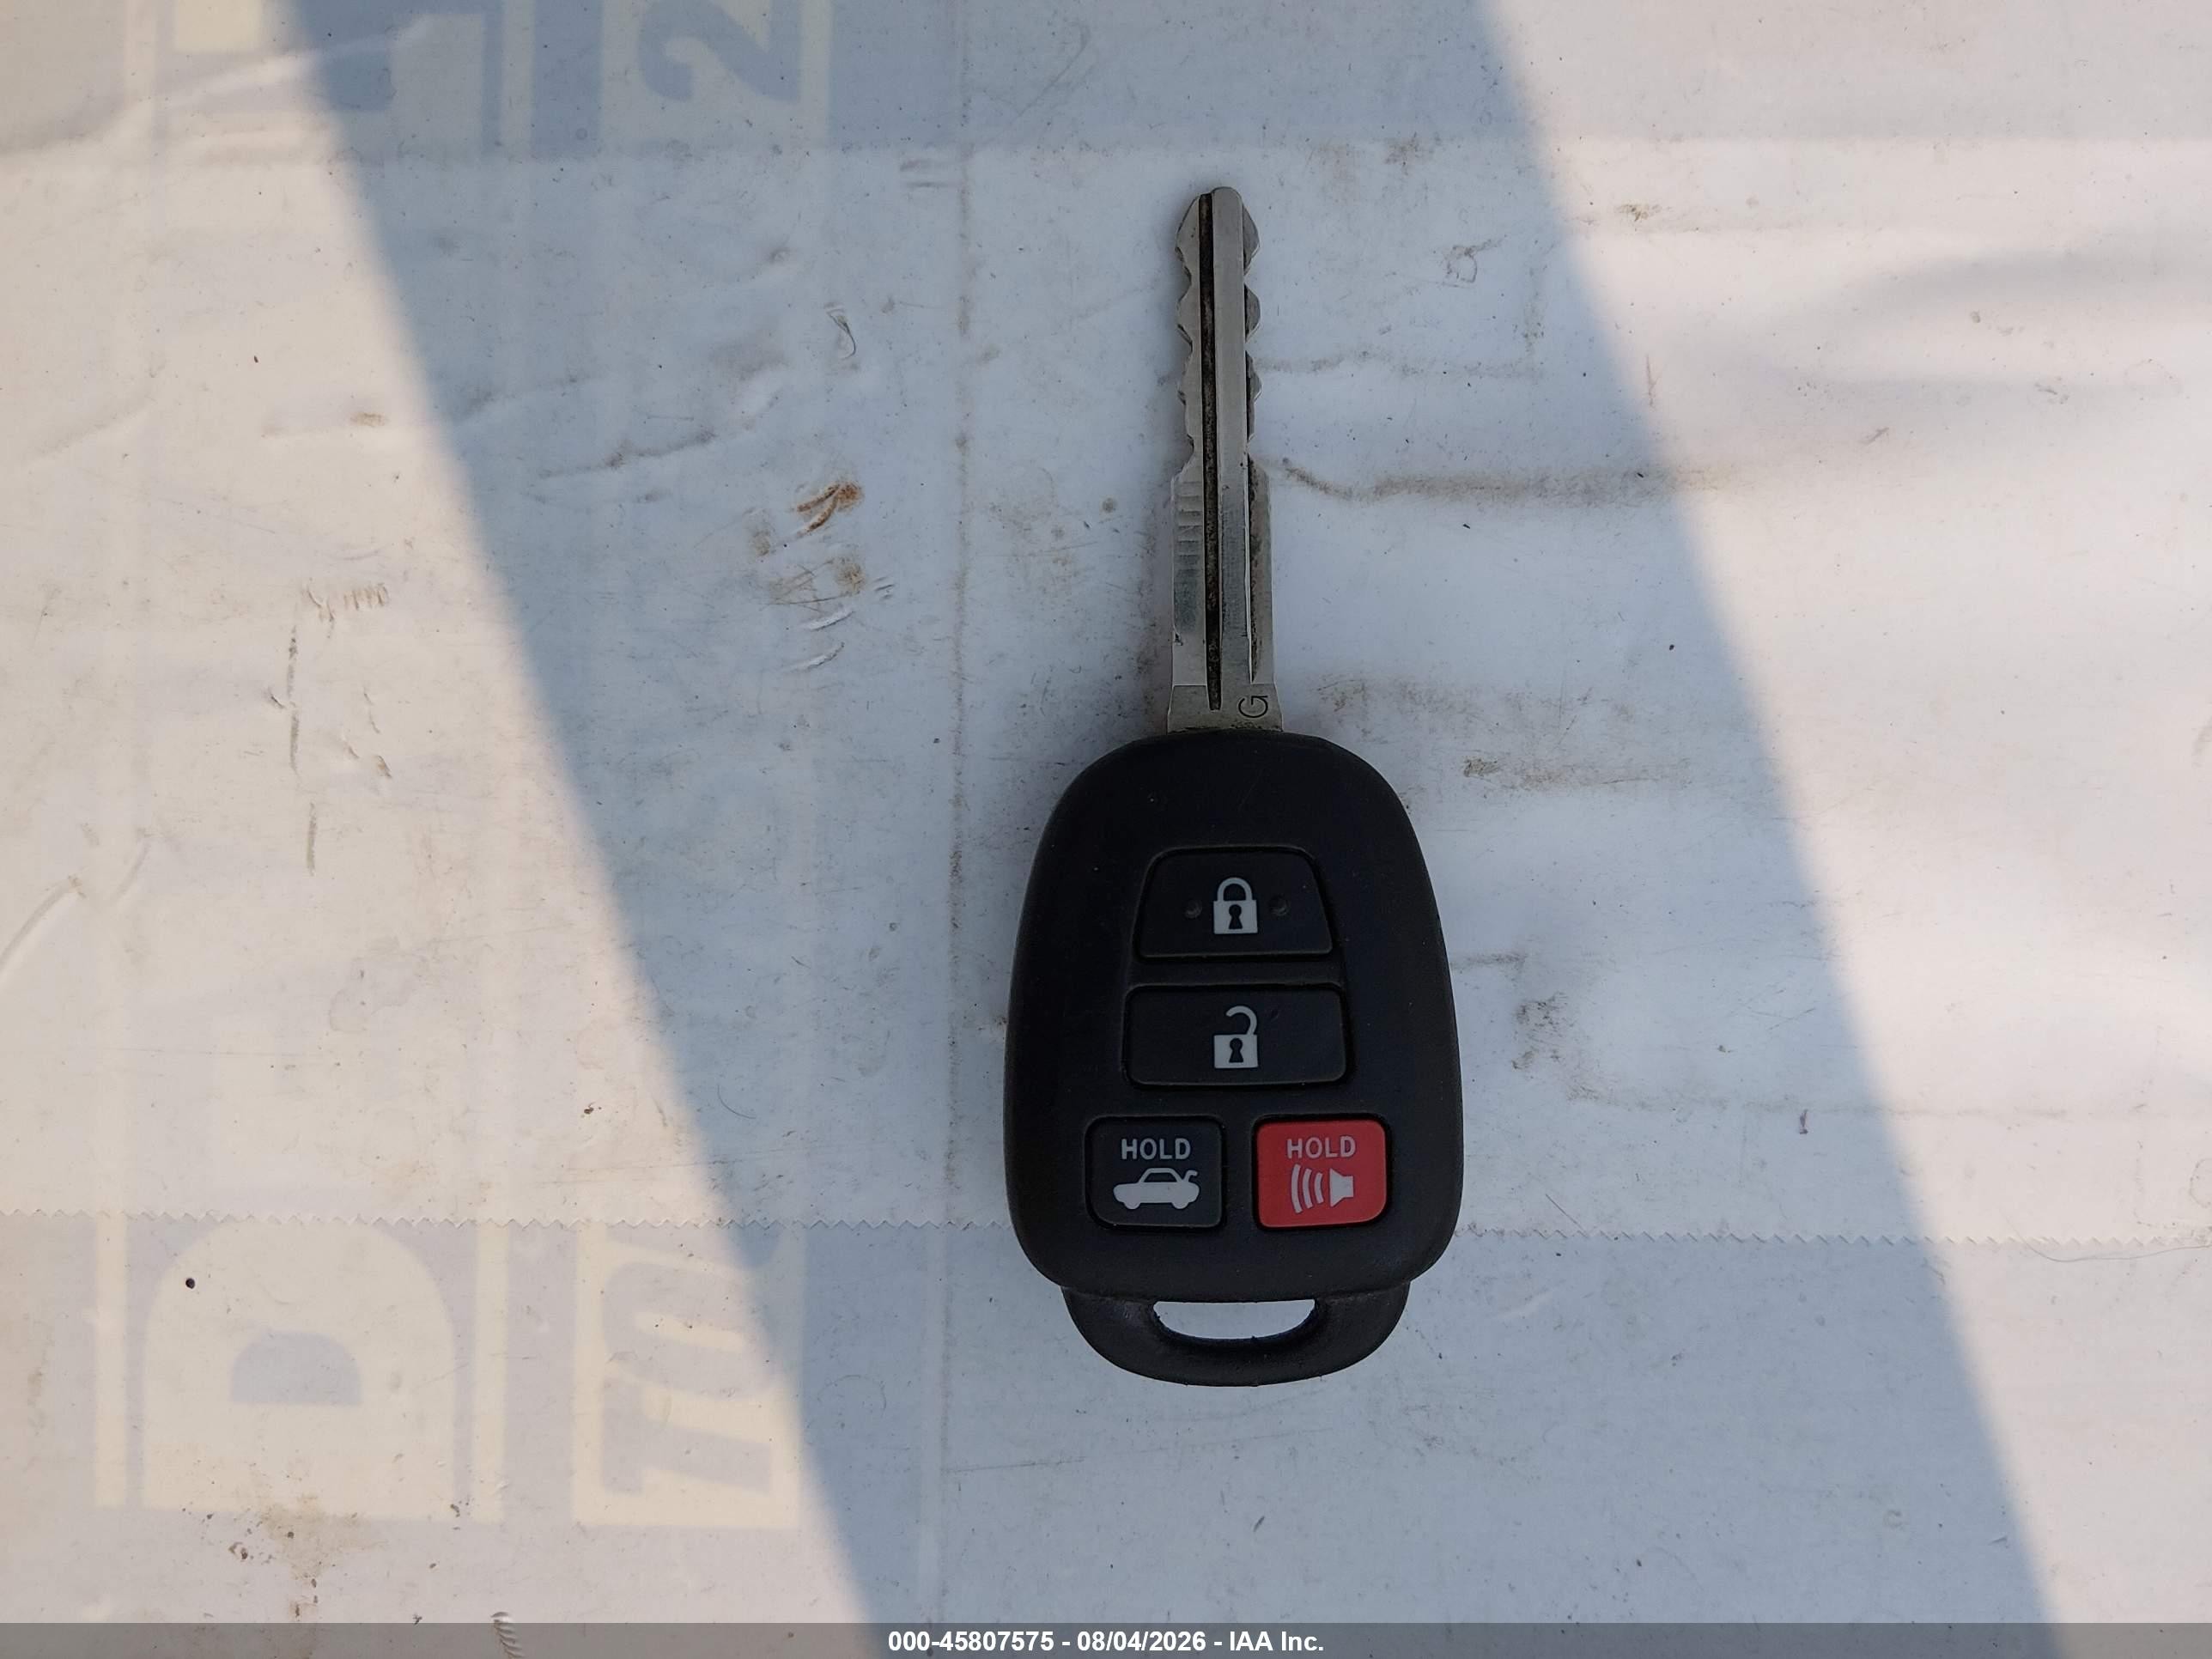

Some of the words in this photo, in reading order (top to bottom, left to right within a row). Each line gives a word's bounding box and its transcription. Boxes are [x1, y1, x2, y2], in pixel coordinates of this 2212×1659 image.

[1237, 695, 1269, 719] G
[1121, 1138, 1191, 1160] HOLD
[1287, 1135, 1356, 1159] HOLD
